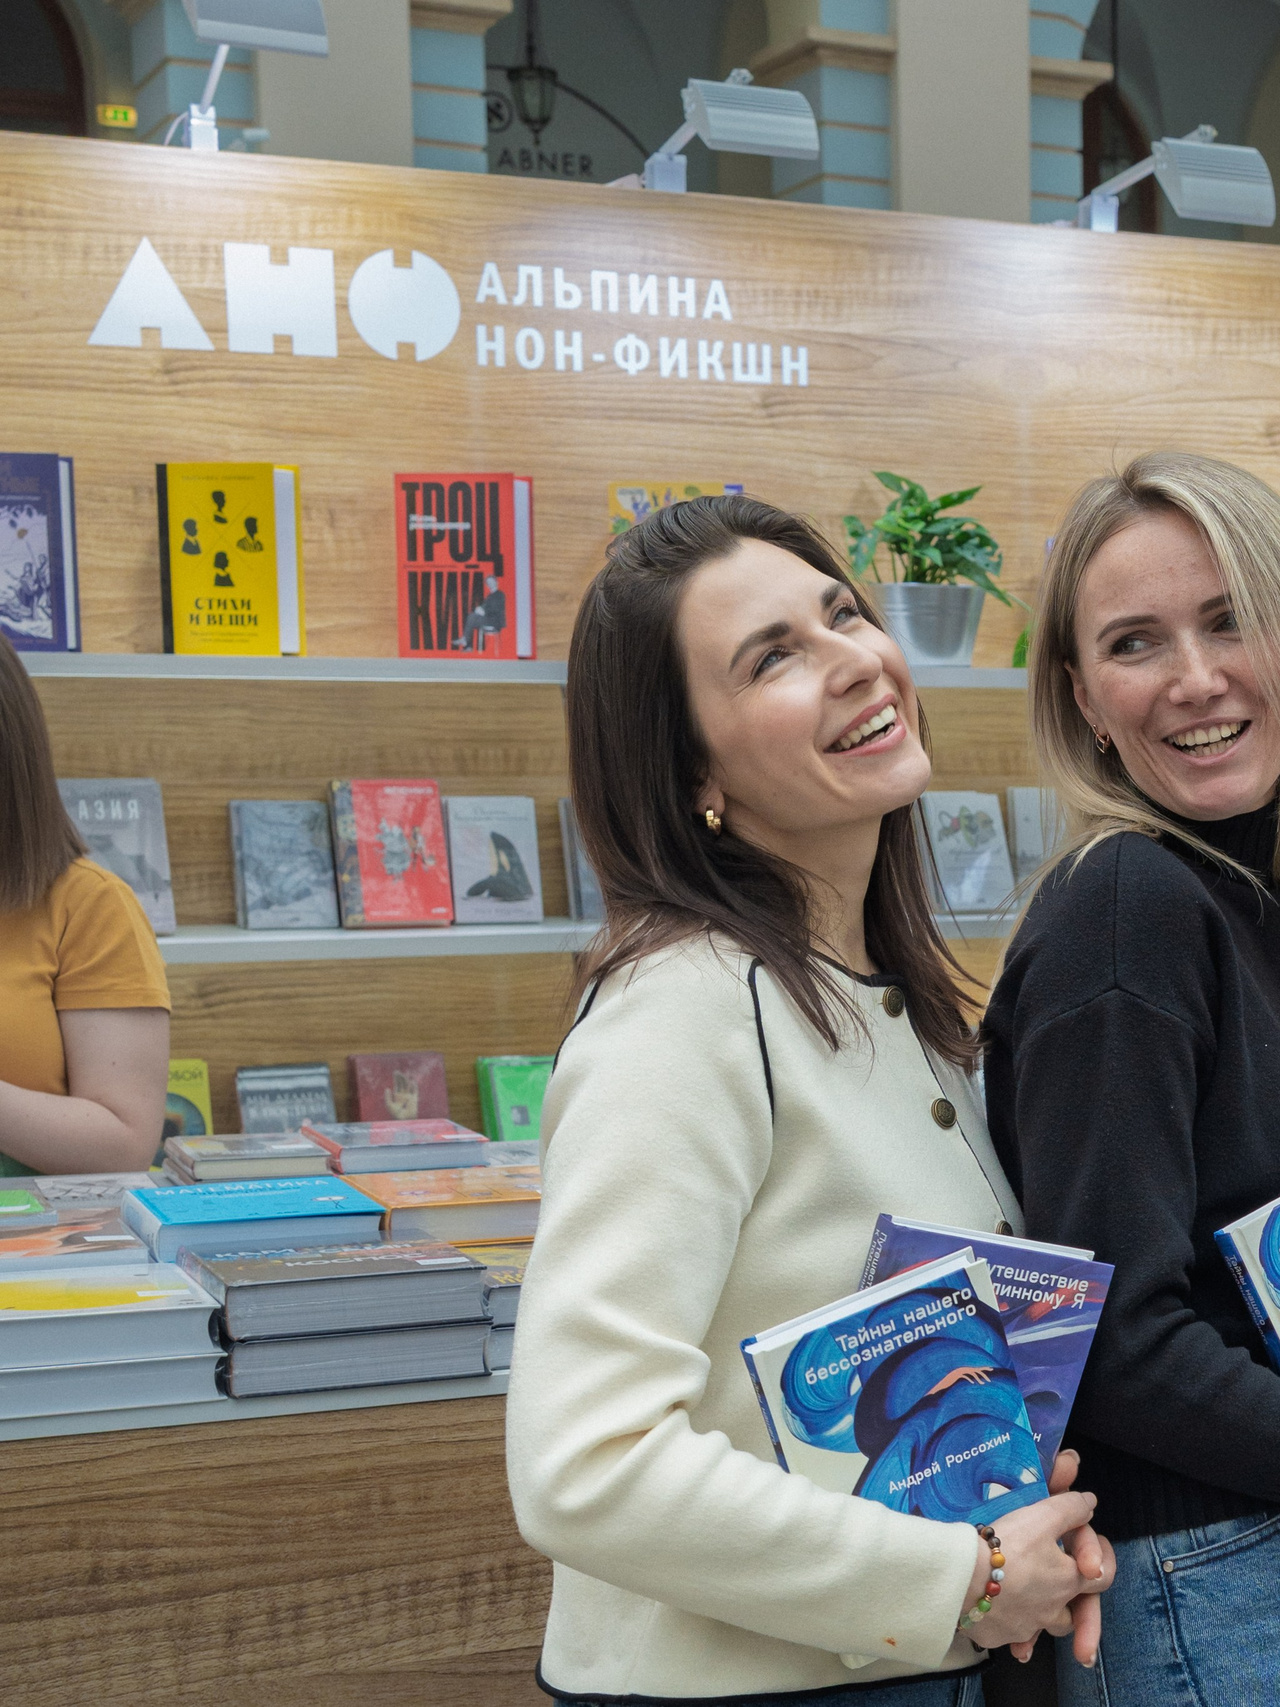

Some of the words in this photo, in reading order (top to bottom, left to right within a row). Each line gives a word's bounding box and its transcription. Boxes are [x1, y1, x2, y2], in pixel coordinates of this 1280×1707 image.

[476, 262, 733, 321] АЛЬПИНА
[476, 324, 809, 386] НОН-ФИКШН
[402, 481, 504, 577] ТРОЦ
[189, 613, 200, 625] И
[207, 613, 258, 626] ВЕЩИ
[194, 597, 251, 610] СТИХИ
[78, 799, 140, 820] АЗИЯ
[155, 1179, 329, 1196] МАТЕМАТИКА
[987, 1264, 1089, 1292] утешествие
[992, 1282, 1065, 1310] линному
[1071, 1293, 1086, 1310] Я
[835, 1318, 896, 1353] Тайны
[903, 1286, 973, 1324] нашего
[805, 1302, 978, 1386] бессознательного
[888, 1461, 941, 1494] Андрей
[945, 1431, 1011, 1468] Россохин
